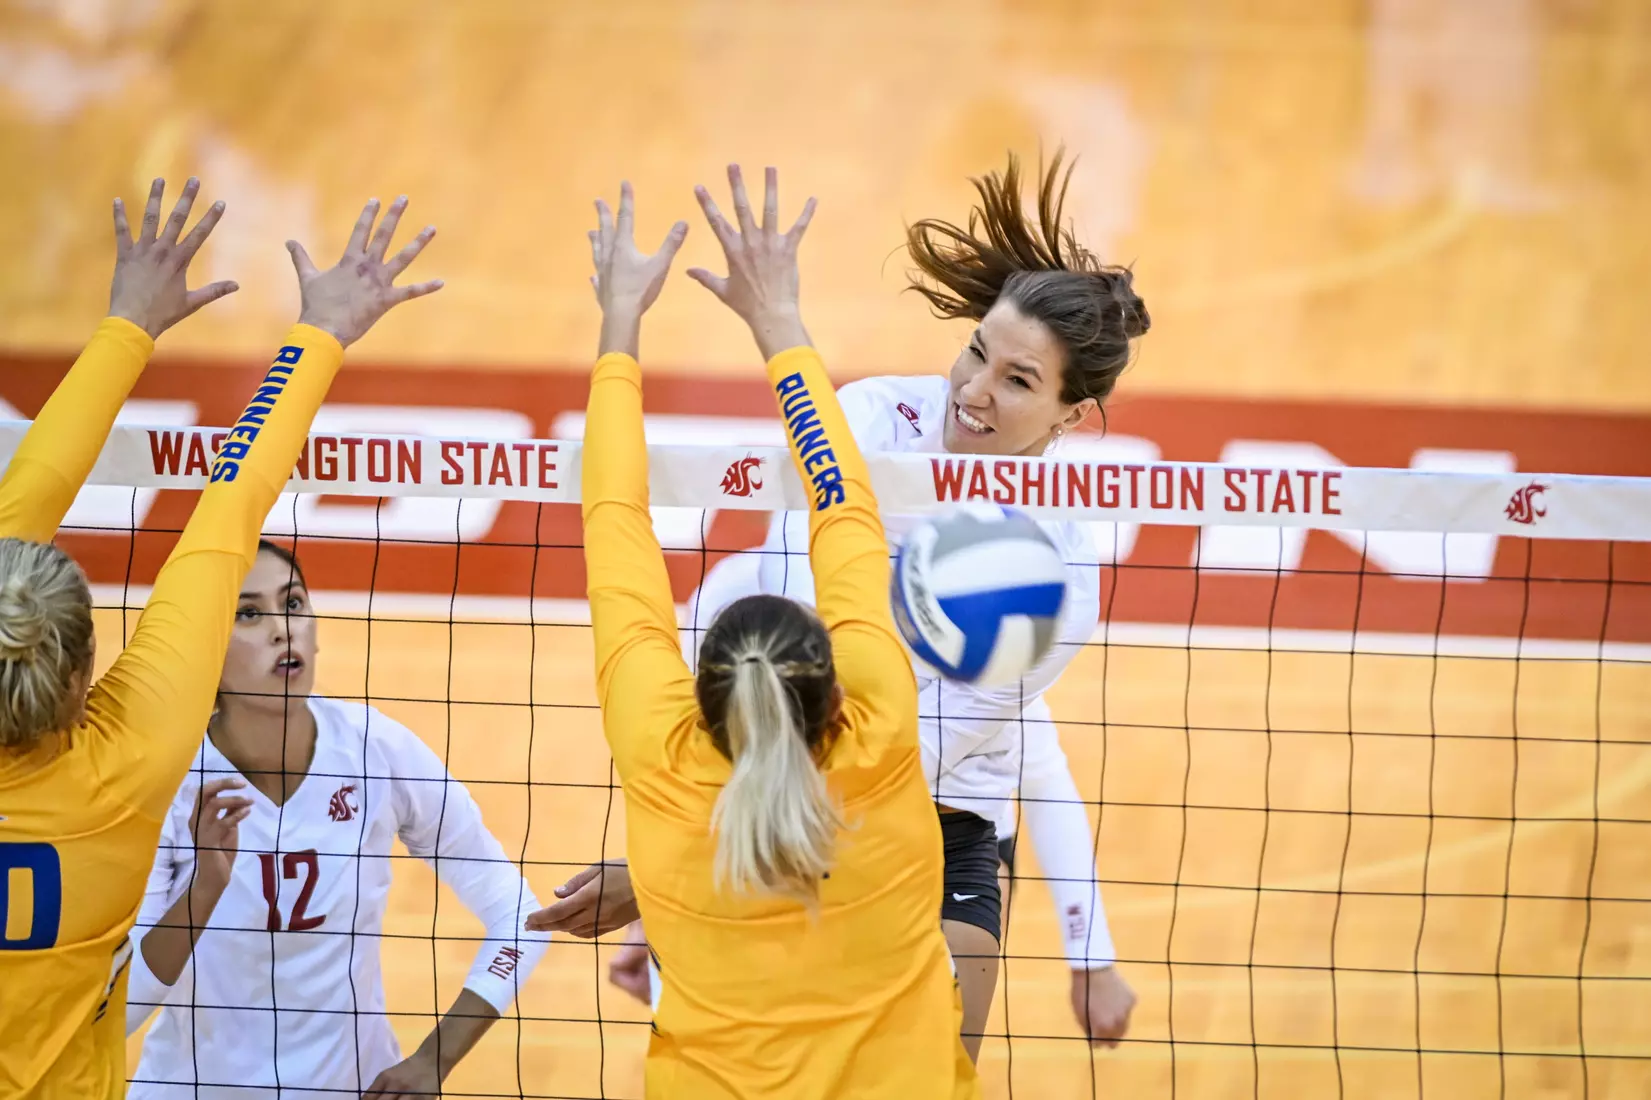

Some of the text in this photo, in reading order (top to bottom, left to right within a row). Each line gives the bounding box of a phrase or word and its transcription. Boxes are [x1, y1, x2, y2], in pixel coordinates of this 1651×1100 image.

[211, 346, 304, 483] RUNNERS
[776, 371, 846, 511] RUNNERS
[147, 429, 559, 489] WANGTON STATE
[931, 458, 1342, 515] WASHINGTON STATE
[257, 848, 327, 932] 12
[487, 946, 524, 980] WSU
